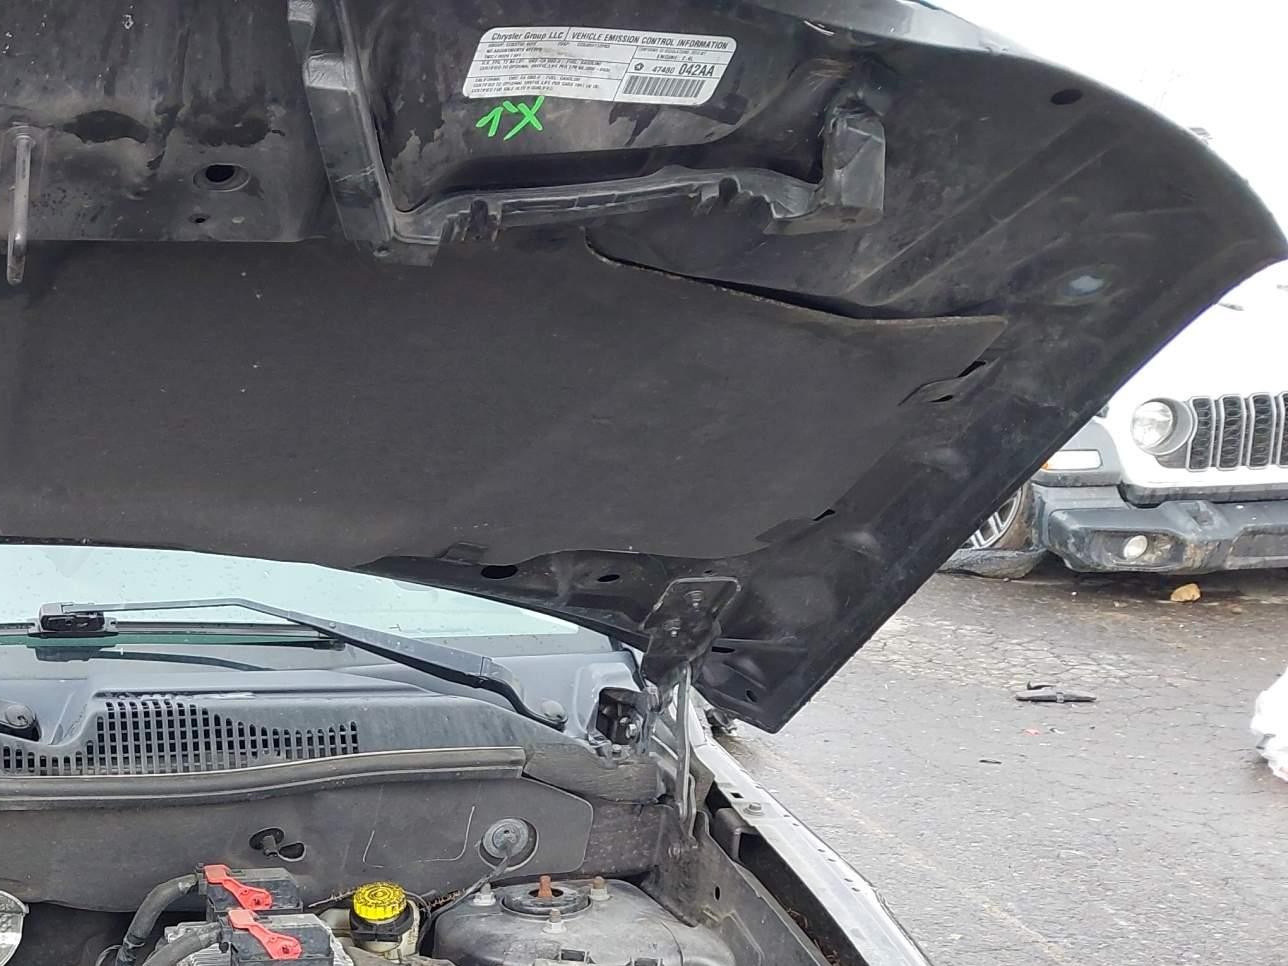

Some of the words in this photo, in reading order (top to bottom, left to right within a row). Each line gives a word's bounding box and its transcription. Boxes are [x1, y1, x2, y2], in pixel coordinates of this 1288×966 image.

[491, 32, 522, 43] Chrysler
[523, 31, 547, 41] Group
[548, 31, 564, 39] LLC
[571, 31, 604, 41] VEHICLE
[603, 33, 640, 43] EMISSION
[641, 36, 674, 46] CONTROL
[676, 39, 728, 49] INFORMATION
[678, 62, 715, 77] 042AA
